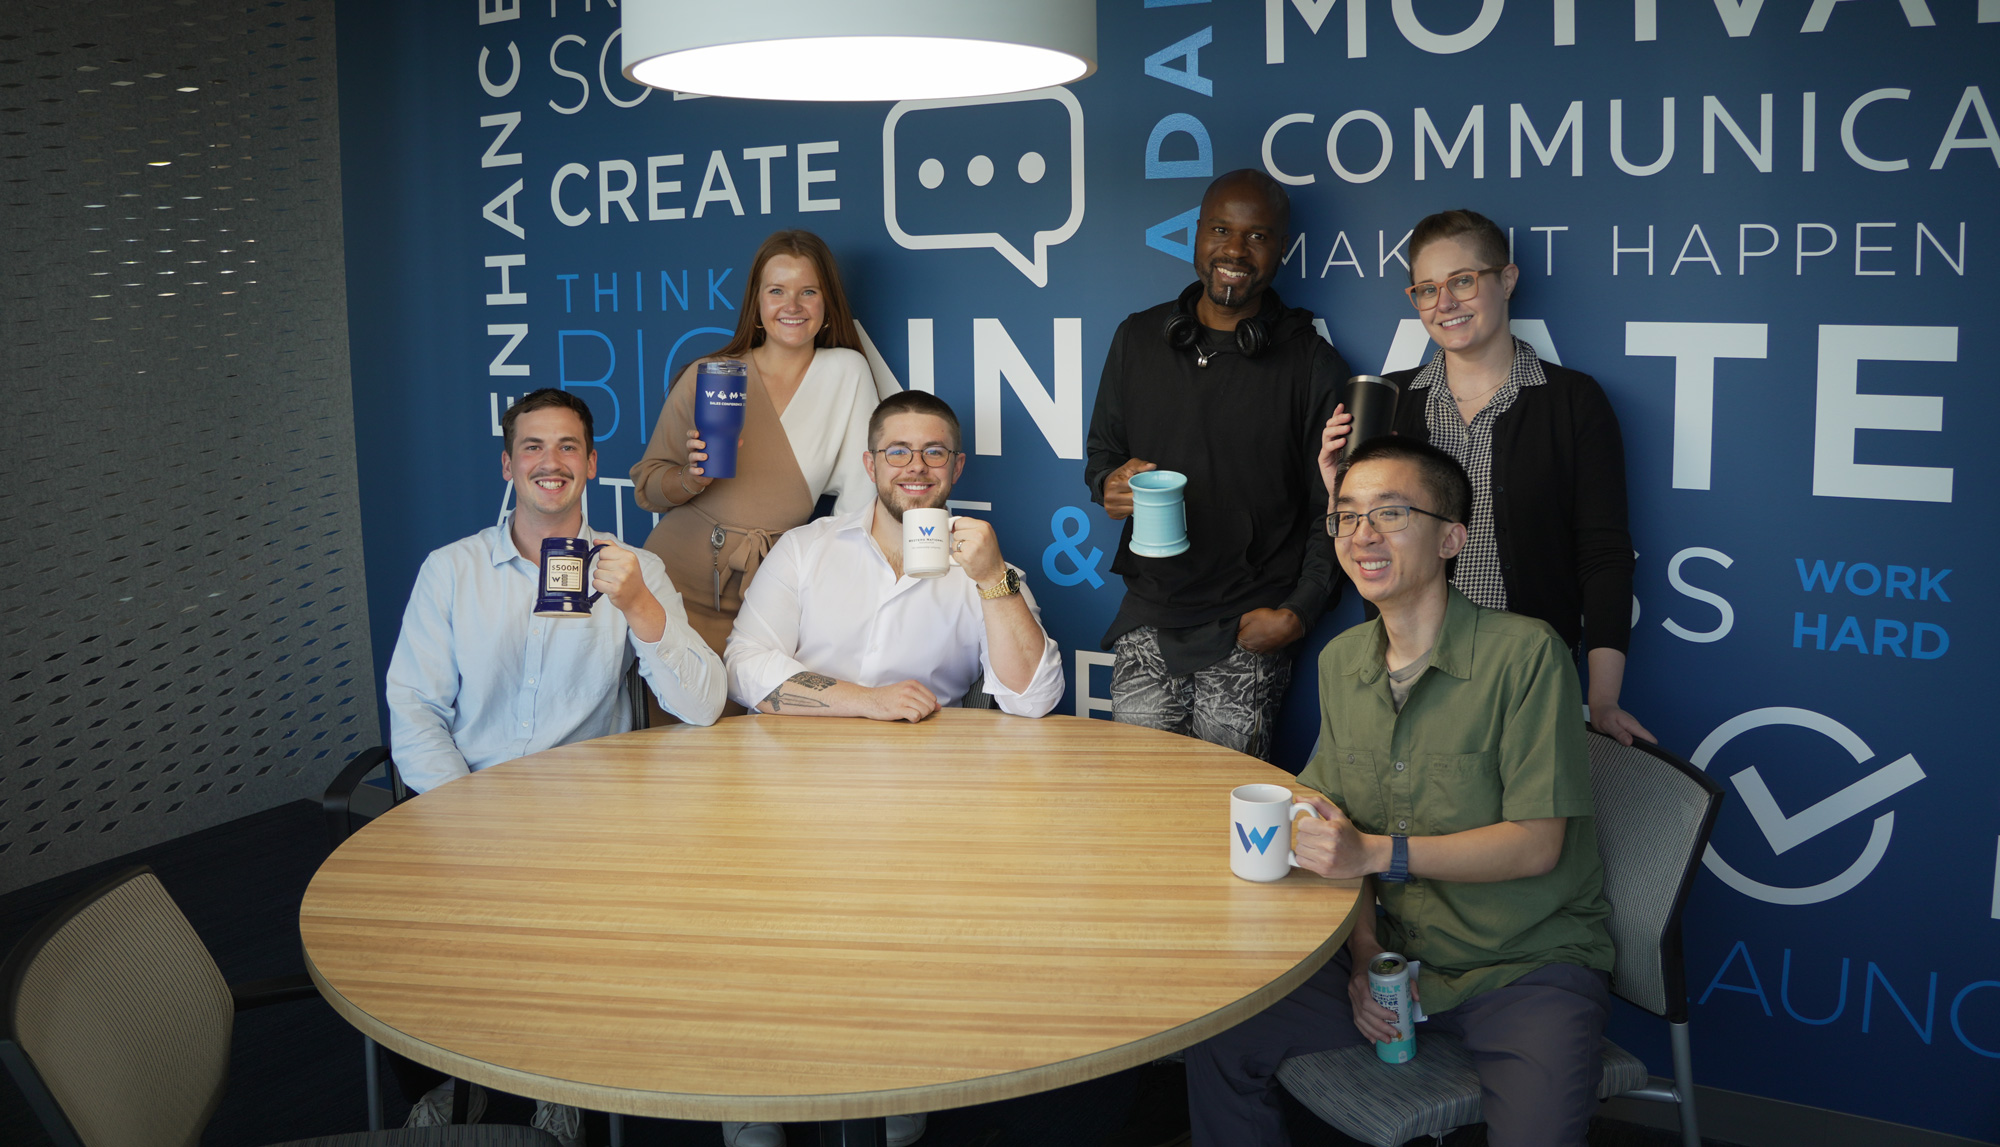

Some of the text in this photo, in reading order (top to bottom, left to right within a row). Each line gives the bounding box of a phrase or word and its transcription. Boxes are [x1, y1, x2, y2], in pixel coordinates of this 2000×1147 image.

[550, 140, 841, 227] CREATE
[1508, 226, 1569, 276] IT
[1612, 221, 1966, 276] HAPPEN
[556, 268, 735, 313] THINK
[918, 526, 935, 536] W
[1041, 505, 1106, 590] &
[1795, 558, 1954, 603] WORK
[1792, 611, 1951, 661] HARD
[1235, 821, 1280, 856] W
